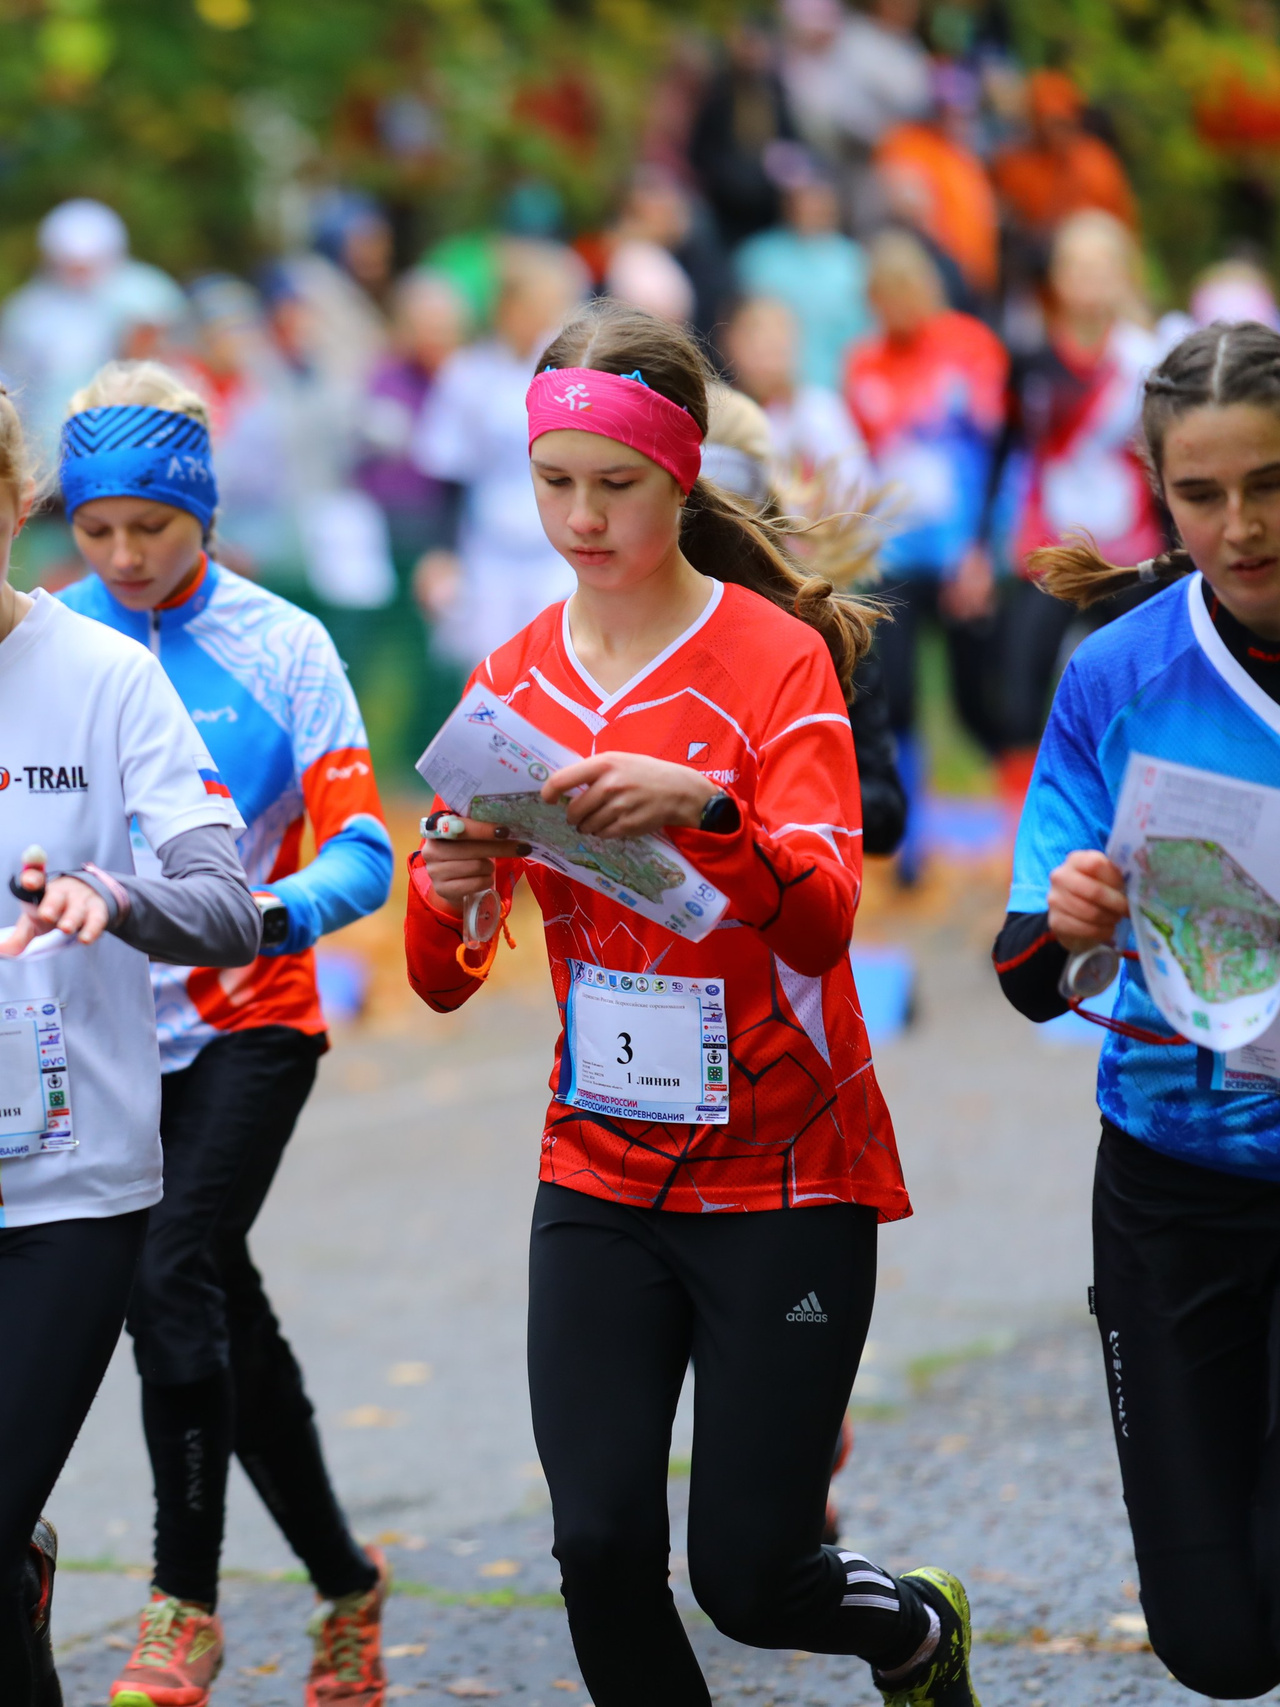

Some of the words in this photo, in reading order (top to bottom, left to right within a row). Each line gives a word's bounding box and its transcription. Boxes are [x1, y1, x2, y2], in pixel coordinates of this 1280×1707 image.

[703, 1034, 727, 1043] evo
[616, 1032, 634, 1065] 3
[627, 1072, 632, 1084] 1
[636, 1075, 681, 1088] линия
[576, 1087, 609, 1104] ПЕРВЕНСТВО
[610, 1096, 638, 1108] РОССИИ
[623, 1109, 685, 1122] СОРЕВНОВАНИЯ
[785, 1311, 828, 1323] adidas
